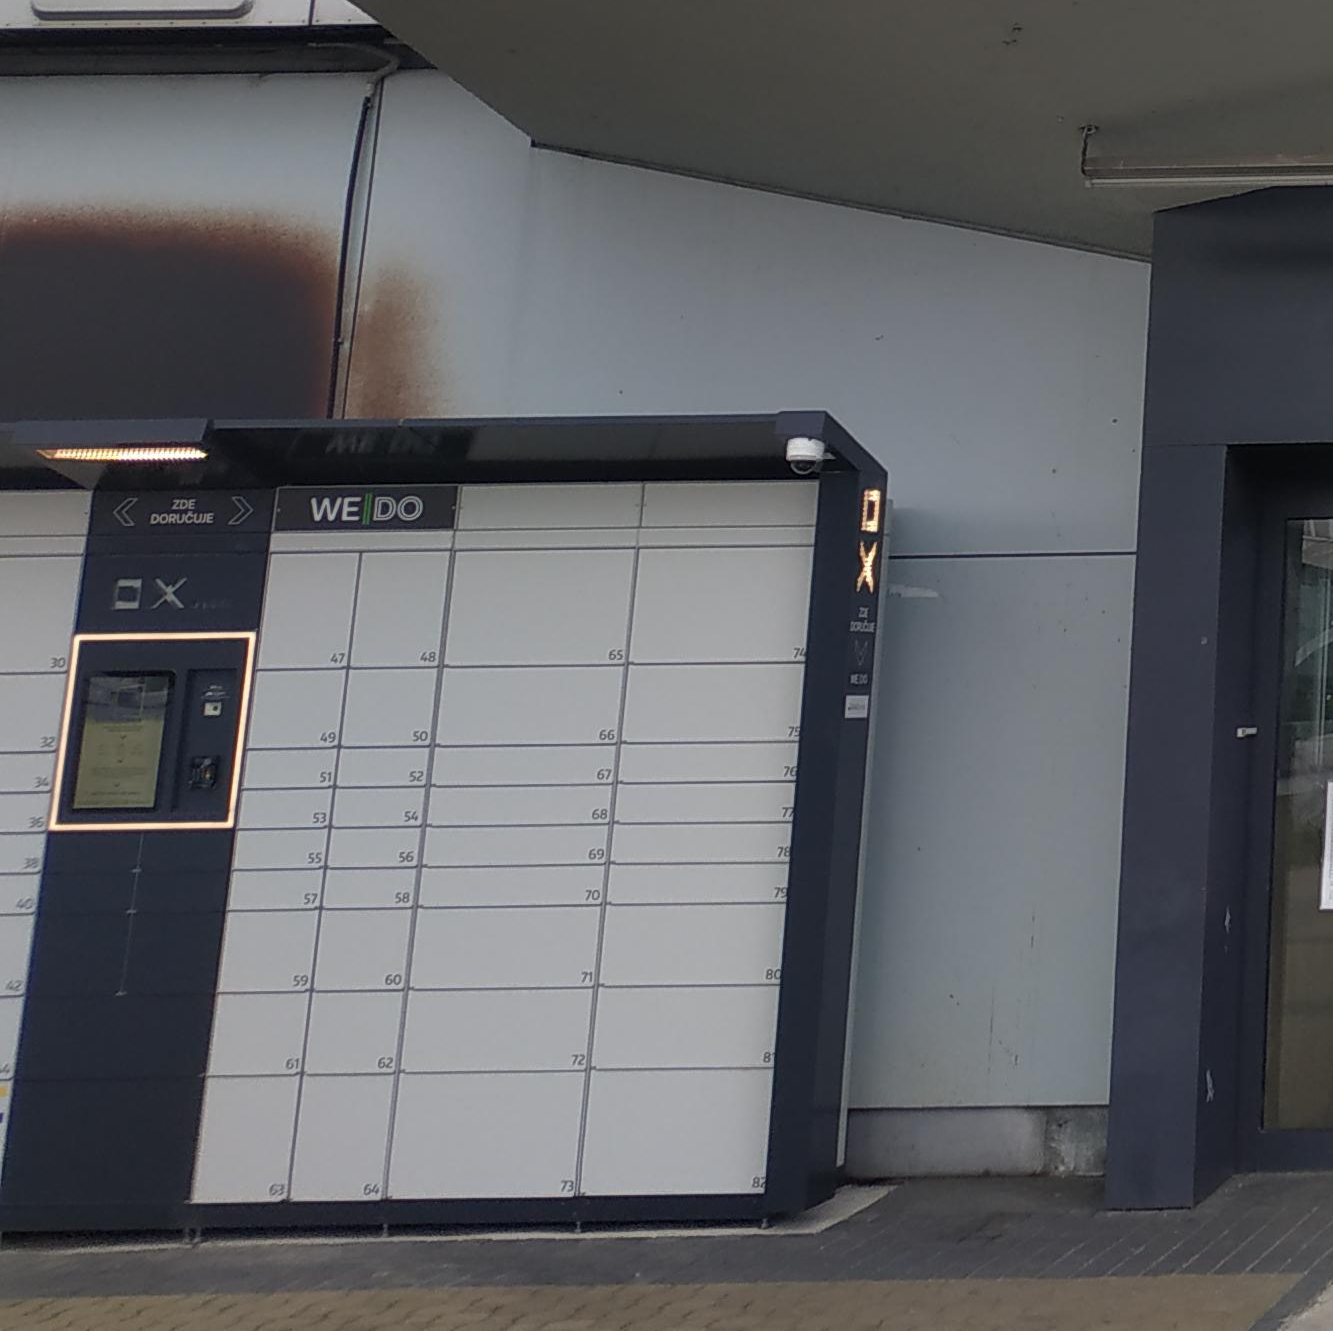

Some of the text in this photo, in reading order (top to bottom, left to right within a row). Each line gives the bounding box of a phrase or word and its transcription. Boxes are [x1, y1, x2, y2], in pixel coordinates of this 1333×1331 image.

[171, 498, 197, 510] ZDE
[150, 510, 214, 525] DORUČUJE
[330, 653, 345, 664] 47
[420, 652, 436, 663] 48
[609, 649, 623, 661] 65
[50, 657, 66, 668] 30
[412, 731, 428, 742] 50
[599, 729, 615, 741] 66
[788, 726, 800, 737] 75
[320, 732, 336, 743] 49
[319, 771, 332, 783] 51
[408, 771, 424, 782] 52
[596, 769, 612, 780] 67
[312, 812, 327, 823] 53
[404, 811, 419, 822] 54
[592, 809, 608, 820] 68
[781, 807, 796, 818] 77
[308, 852, 322, 863] 55
[399, 851, 414, 862] 56
[588, 849, 604, 860] 69
[777, 847, 791, 858] 78
[395, 892, 410, 903] 58
[585, 890, 600, 901] 70
[774, 887, 788, 898] 79
[303, 893, 318, 904] 57
[293, 975, 308, 986] 59
[385, 974, 401, 986] 60
[581, 972, 593, 983] 71
[765, 969, 781, 981] 80
[285, 1058, 299, 1069] 61
[377, 1057, 393, 1069] 62
[572, 1054, 585, 1065] 72
[269, 1184, 285, 1195] 63
[363, 1184, 380, 1195] 64
[561, 1180, 574, 1192] 73
